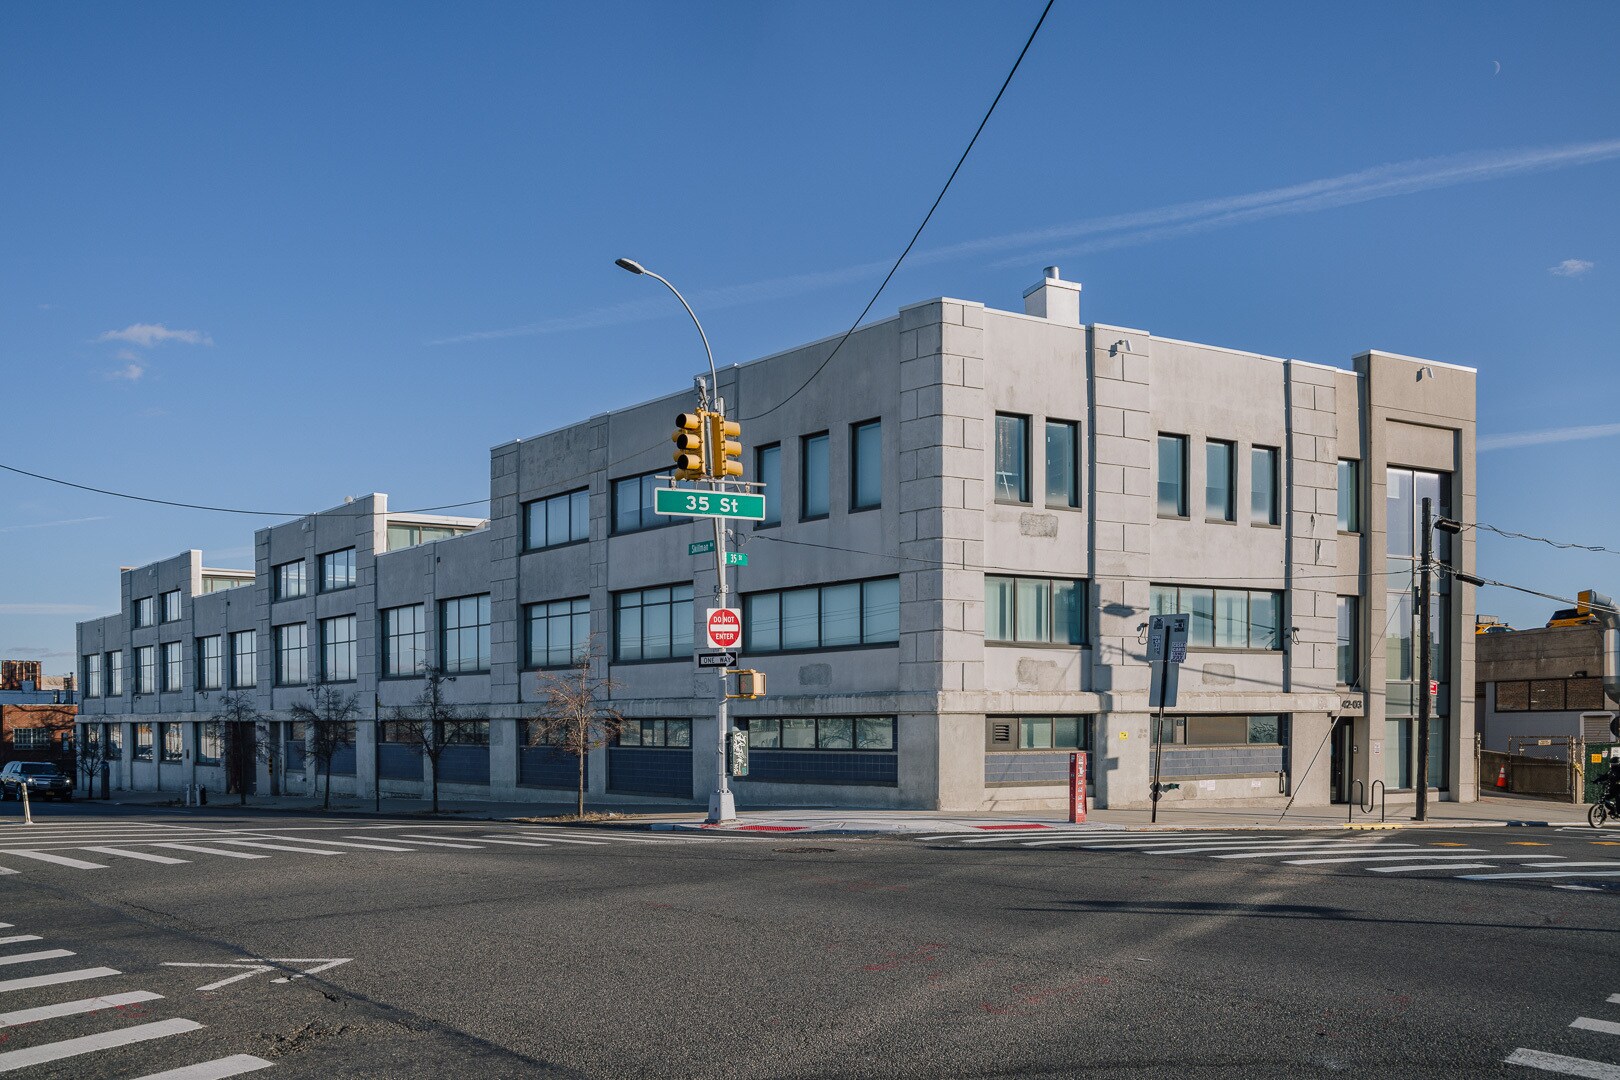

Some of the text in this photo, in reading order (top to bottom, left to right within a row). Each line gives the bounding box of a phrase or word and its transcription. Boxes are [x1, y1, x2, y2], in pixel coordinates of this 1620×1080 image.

[686, 496, 738, 512] 35 St
[692, 544, 708, 554] Skillman
[730, 554, 737, 564] 35
[1342, 700, 1362, 709] 42-03
